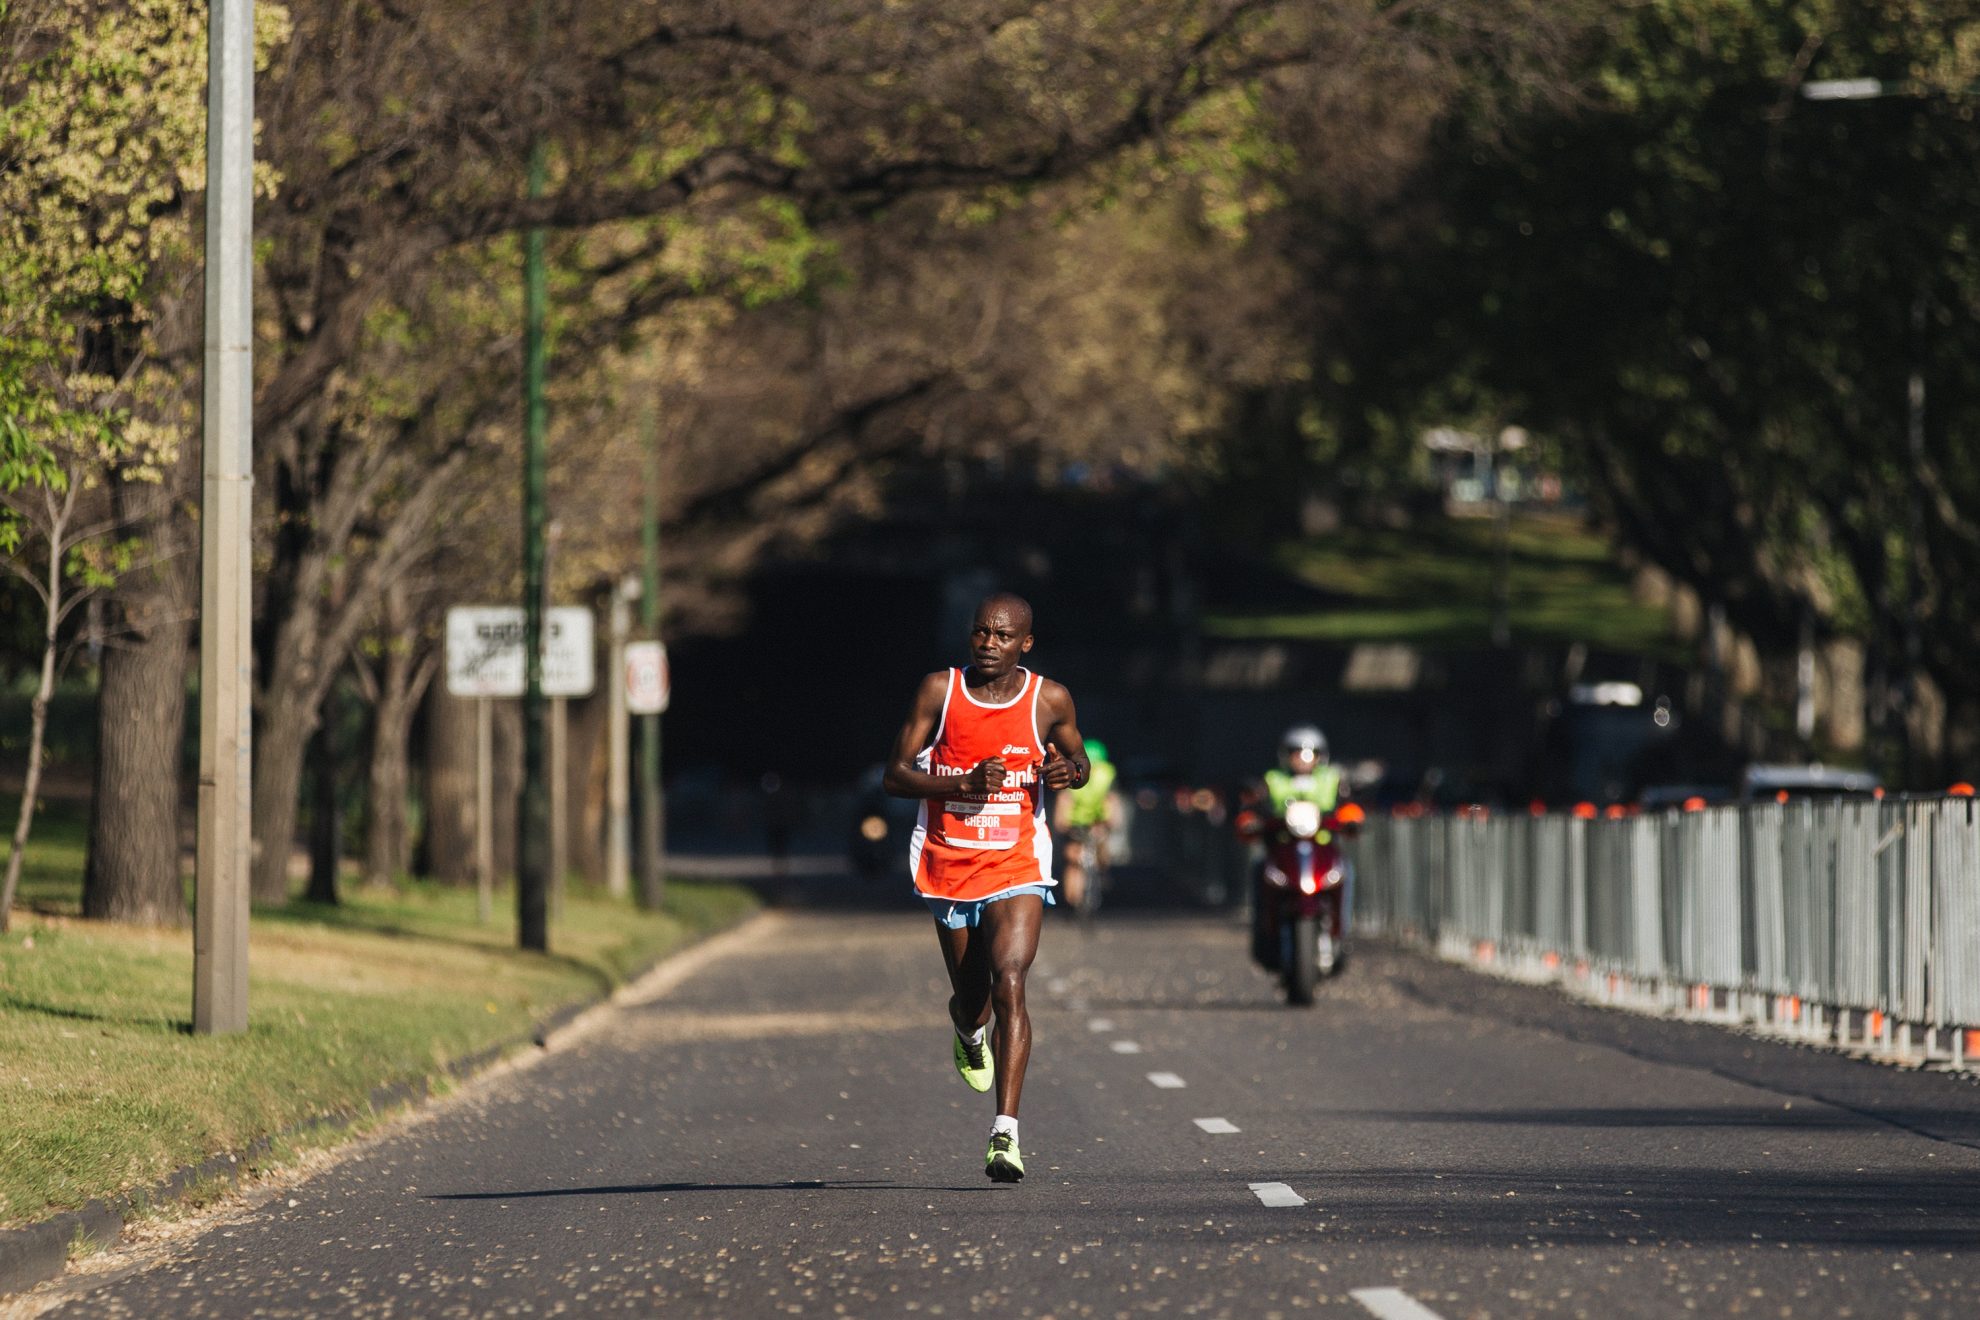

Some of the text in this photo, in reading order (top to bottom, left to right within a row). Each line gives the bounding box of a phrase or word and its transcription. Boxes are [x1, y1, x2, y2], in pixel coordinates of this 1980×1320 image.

[994, 792, 1025, 802] Health
[964, 815, 1000, 828] CHEBOR
[978, 828, 985, 840] 9
